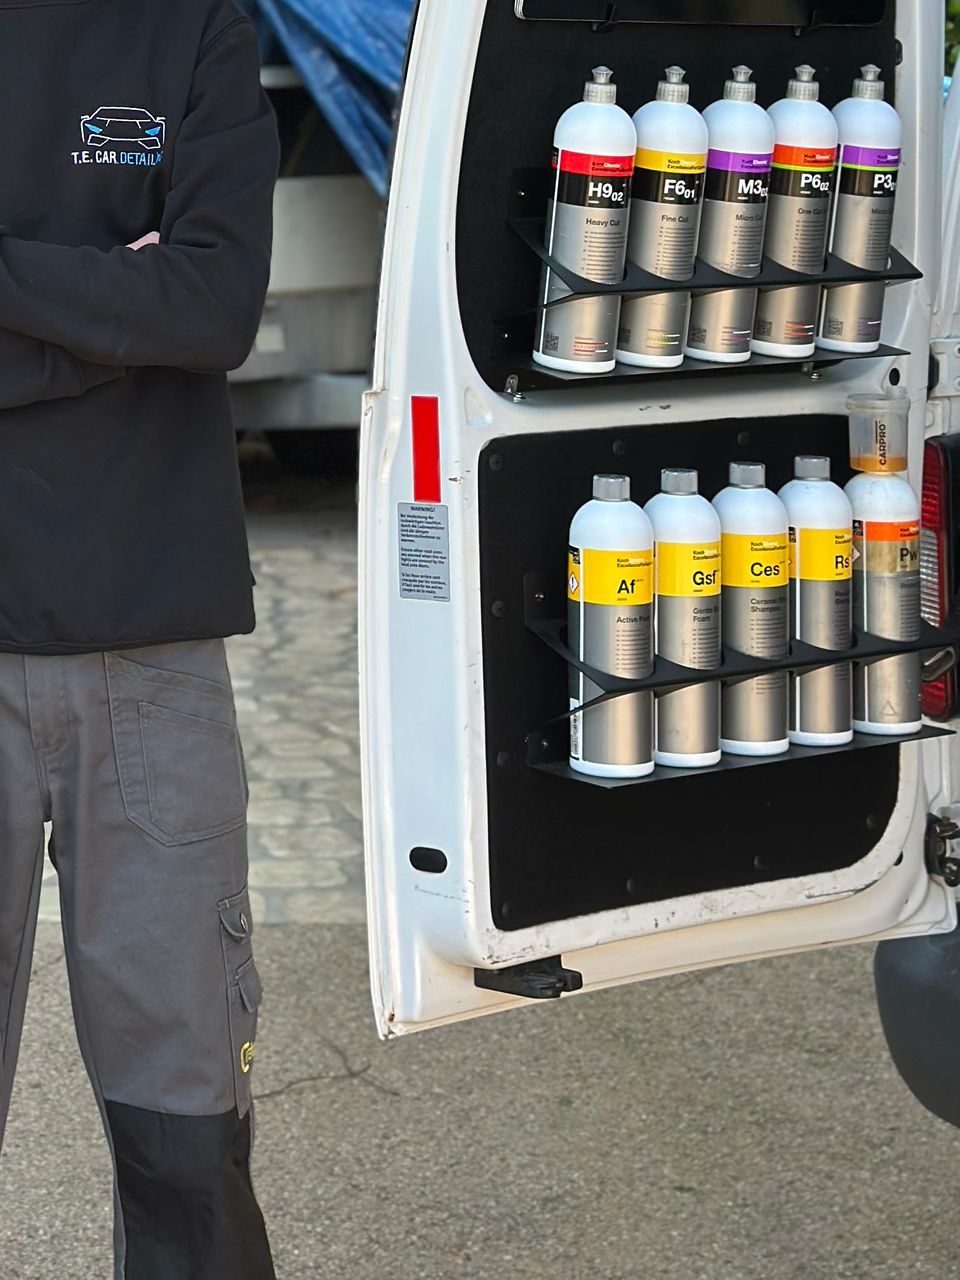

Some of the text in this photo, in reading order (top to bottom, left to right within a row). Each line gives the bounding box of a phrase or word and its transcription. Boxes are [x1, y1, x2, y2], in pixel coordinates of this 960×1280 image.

[71, 150, 163, 166] T.E. CAR DETAIL
[663, 179, 695, 199] F601
[586, 218, 608, 227] Heavy
[878, 423, 887, 466] CARPRO
[835, 555, 849, 569] Rs
[900, 548, 917, 562] Pw
[751, 562, 780, 577] Ces
[693, 570, 717, 586] Gsf
[617, 579, 636, 594] Af
